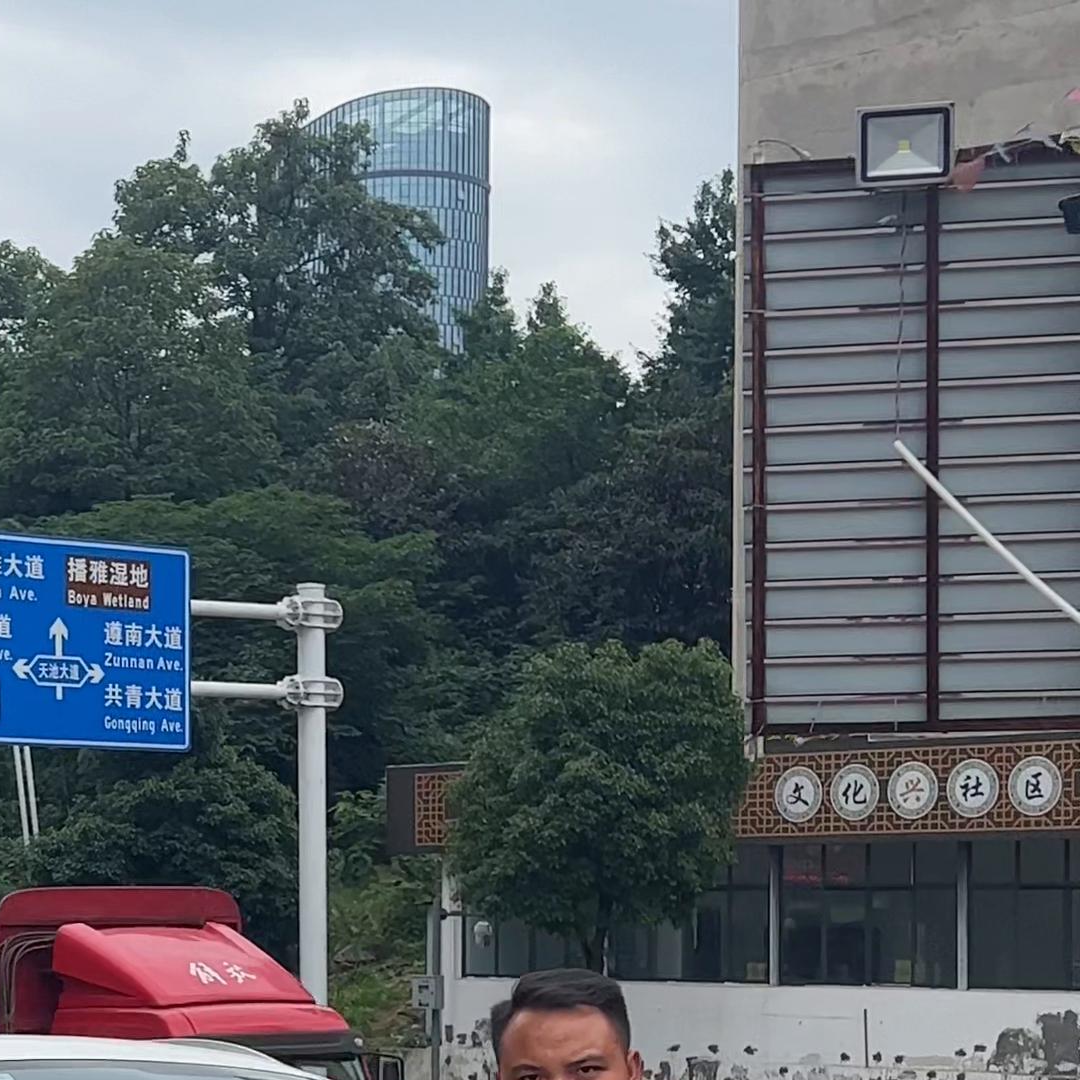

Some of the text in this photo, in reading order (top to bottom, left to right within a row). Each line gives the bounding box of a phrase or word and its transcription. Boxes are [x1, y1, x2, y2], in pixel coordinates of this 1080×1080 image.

[67, 557, 149, 588] 播雅湿地
[10, 586, 38, 602] Ave.
[68, 590, 149, 610] Boya Wetland
[104, 621, 183, 650] 遵南大道
[104, 652, 183, 672] Zunnan Ave.
[104, 683, 183, 711] 共青大道
[104, 715, 183, 735] Gongqing Ave.
